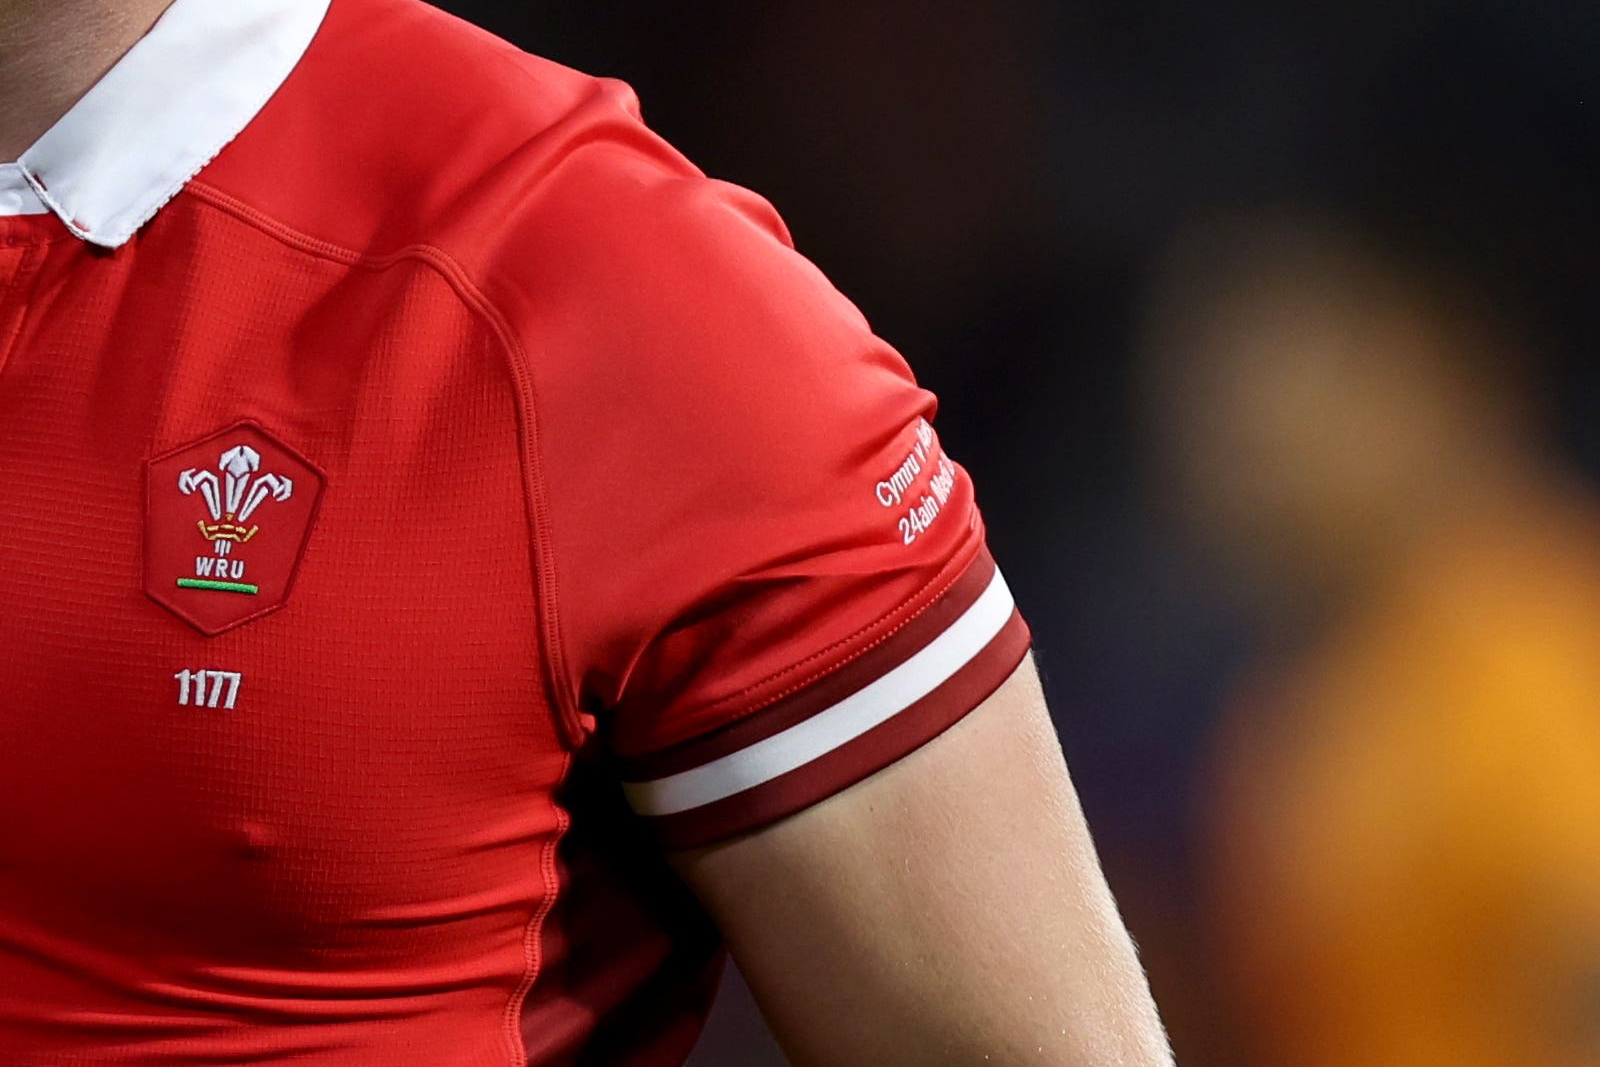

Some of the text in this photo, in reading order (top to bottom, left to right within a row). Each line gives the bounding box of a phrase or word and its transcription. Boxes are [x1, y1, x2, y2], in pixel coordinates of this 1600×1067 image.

[876, 453, 921, 508] Cymru
[898, 496, 940, 546] 24ain
[195, 556, 245, 580] WRU
[174, 668, 242, 710] 1177
